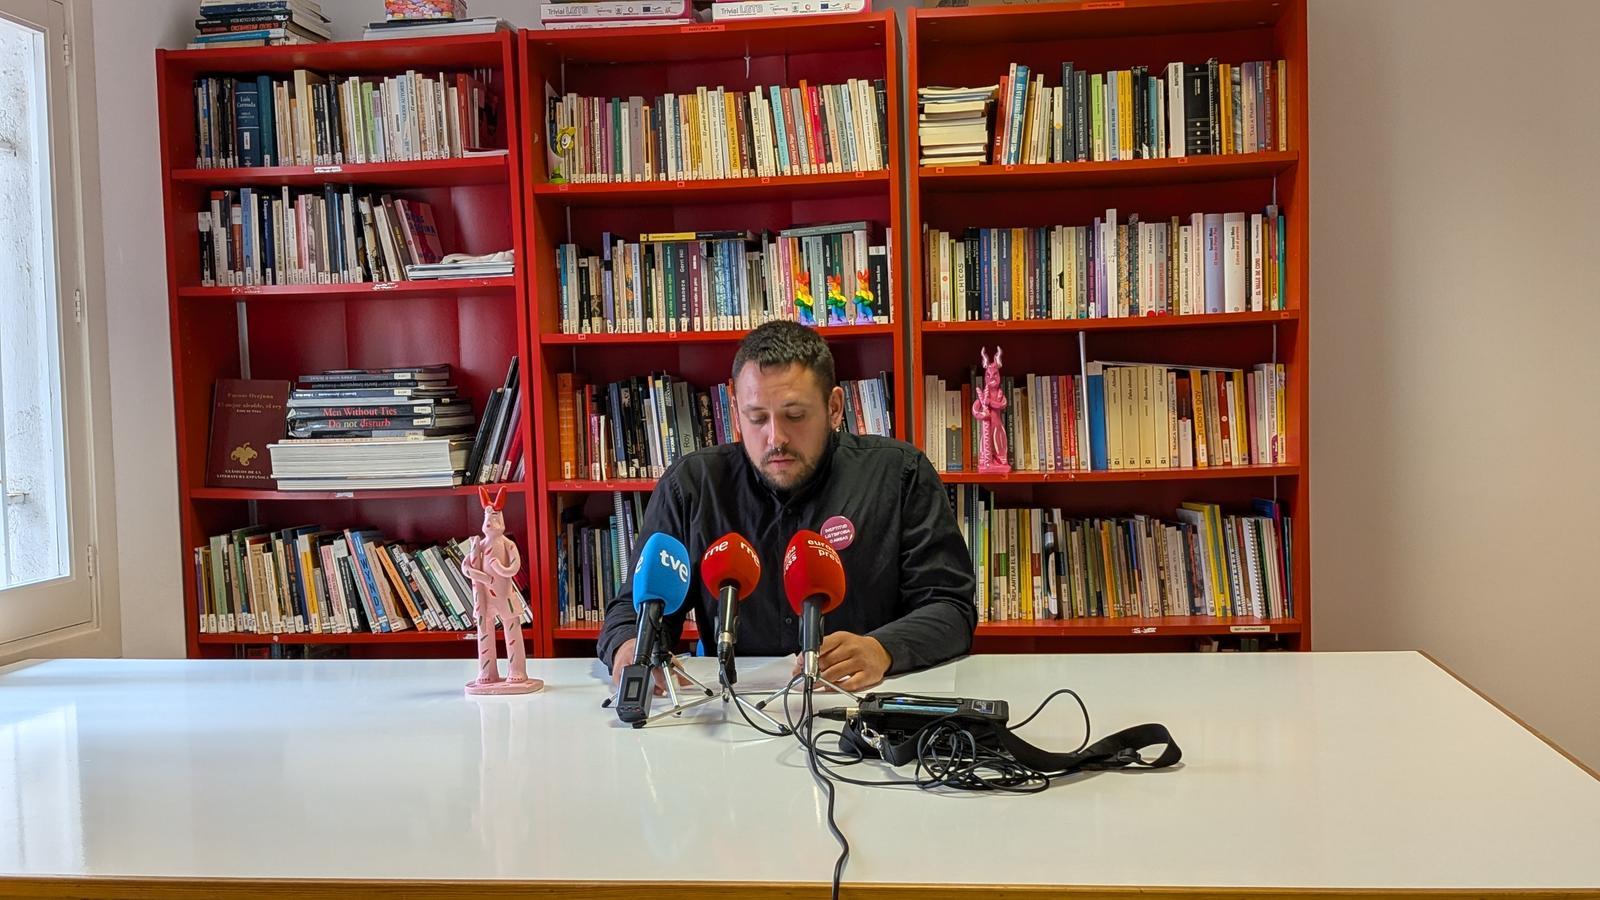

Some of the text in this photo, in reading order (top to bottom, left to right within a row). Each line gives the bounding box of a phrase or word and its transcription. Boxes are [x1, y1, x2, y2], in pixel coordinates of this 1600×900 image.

[322, 407, 397, 417] Men Without Ties
[328, 420, 341, 428] Do
[360, 419, 391, 428] disturb
[704, 540, 729, 560] rne
[740, 541, 760, 567] rne
[659, 550, 688, 582] tve
[360, 560, 380, 606] WYND
